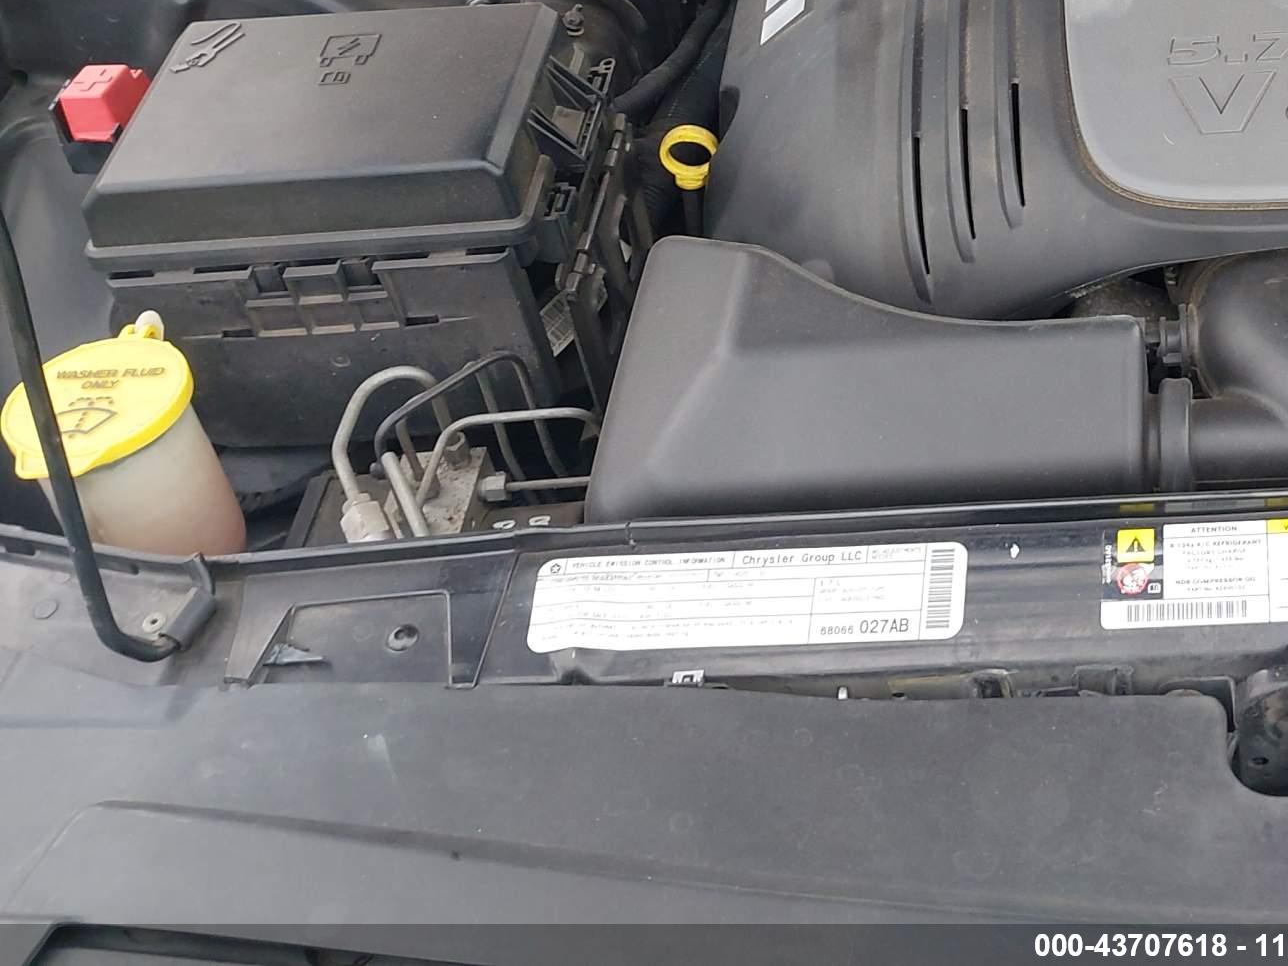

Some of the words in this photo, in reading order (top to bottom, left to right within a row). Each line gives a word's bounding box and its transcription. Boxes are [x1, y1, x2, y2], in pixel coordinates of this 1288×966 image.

[56, 369, 119, 379] WASHER
[122, 367, 166, 378] FLUID
[81, 379, 120, 390] ONLY
[1191, 525, 1238, 534] ATTENTION
[572, 561, 602, 570] VEHICLE
[605, 560, 642, 569] EMISSION
[643, 559, 673, 567] CONTROL
[678, 556, 726, 566] INFORMATION
[741, 553, 795, 568] Chrysler
[801, 551, 836, 566] Group
[840, 550, 863, 562] LLC
[859, 617, 910, 634] 027AB
